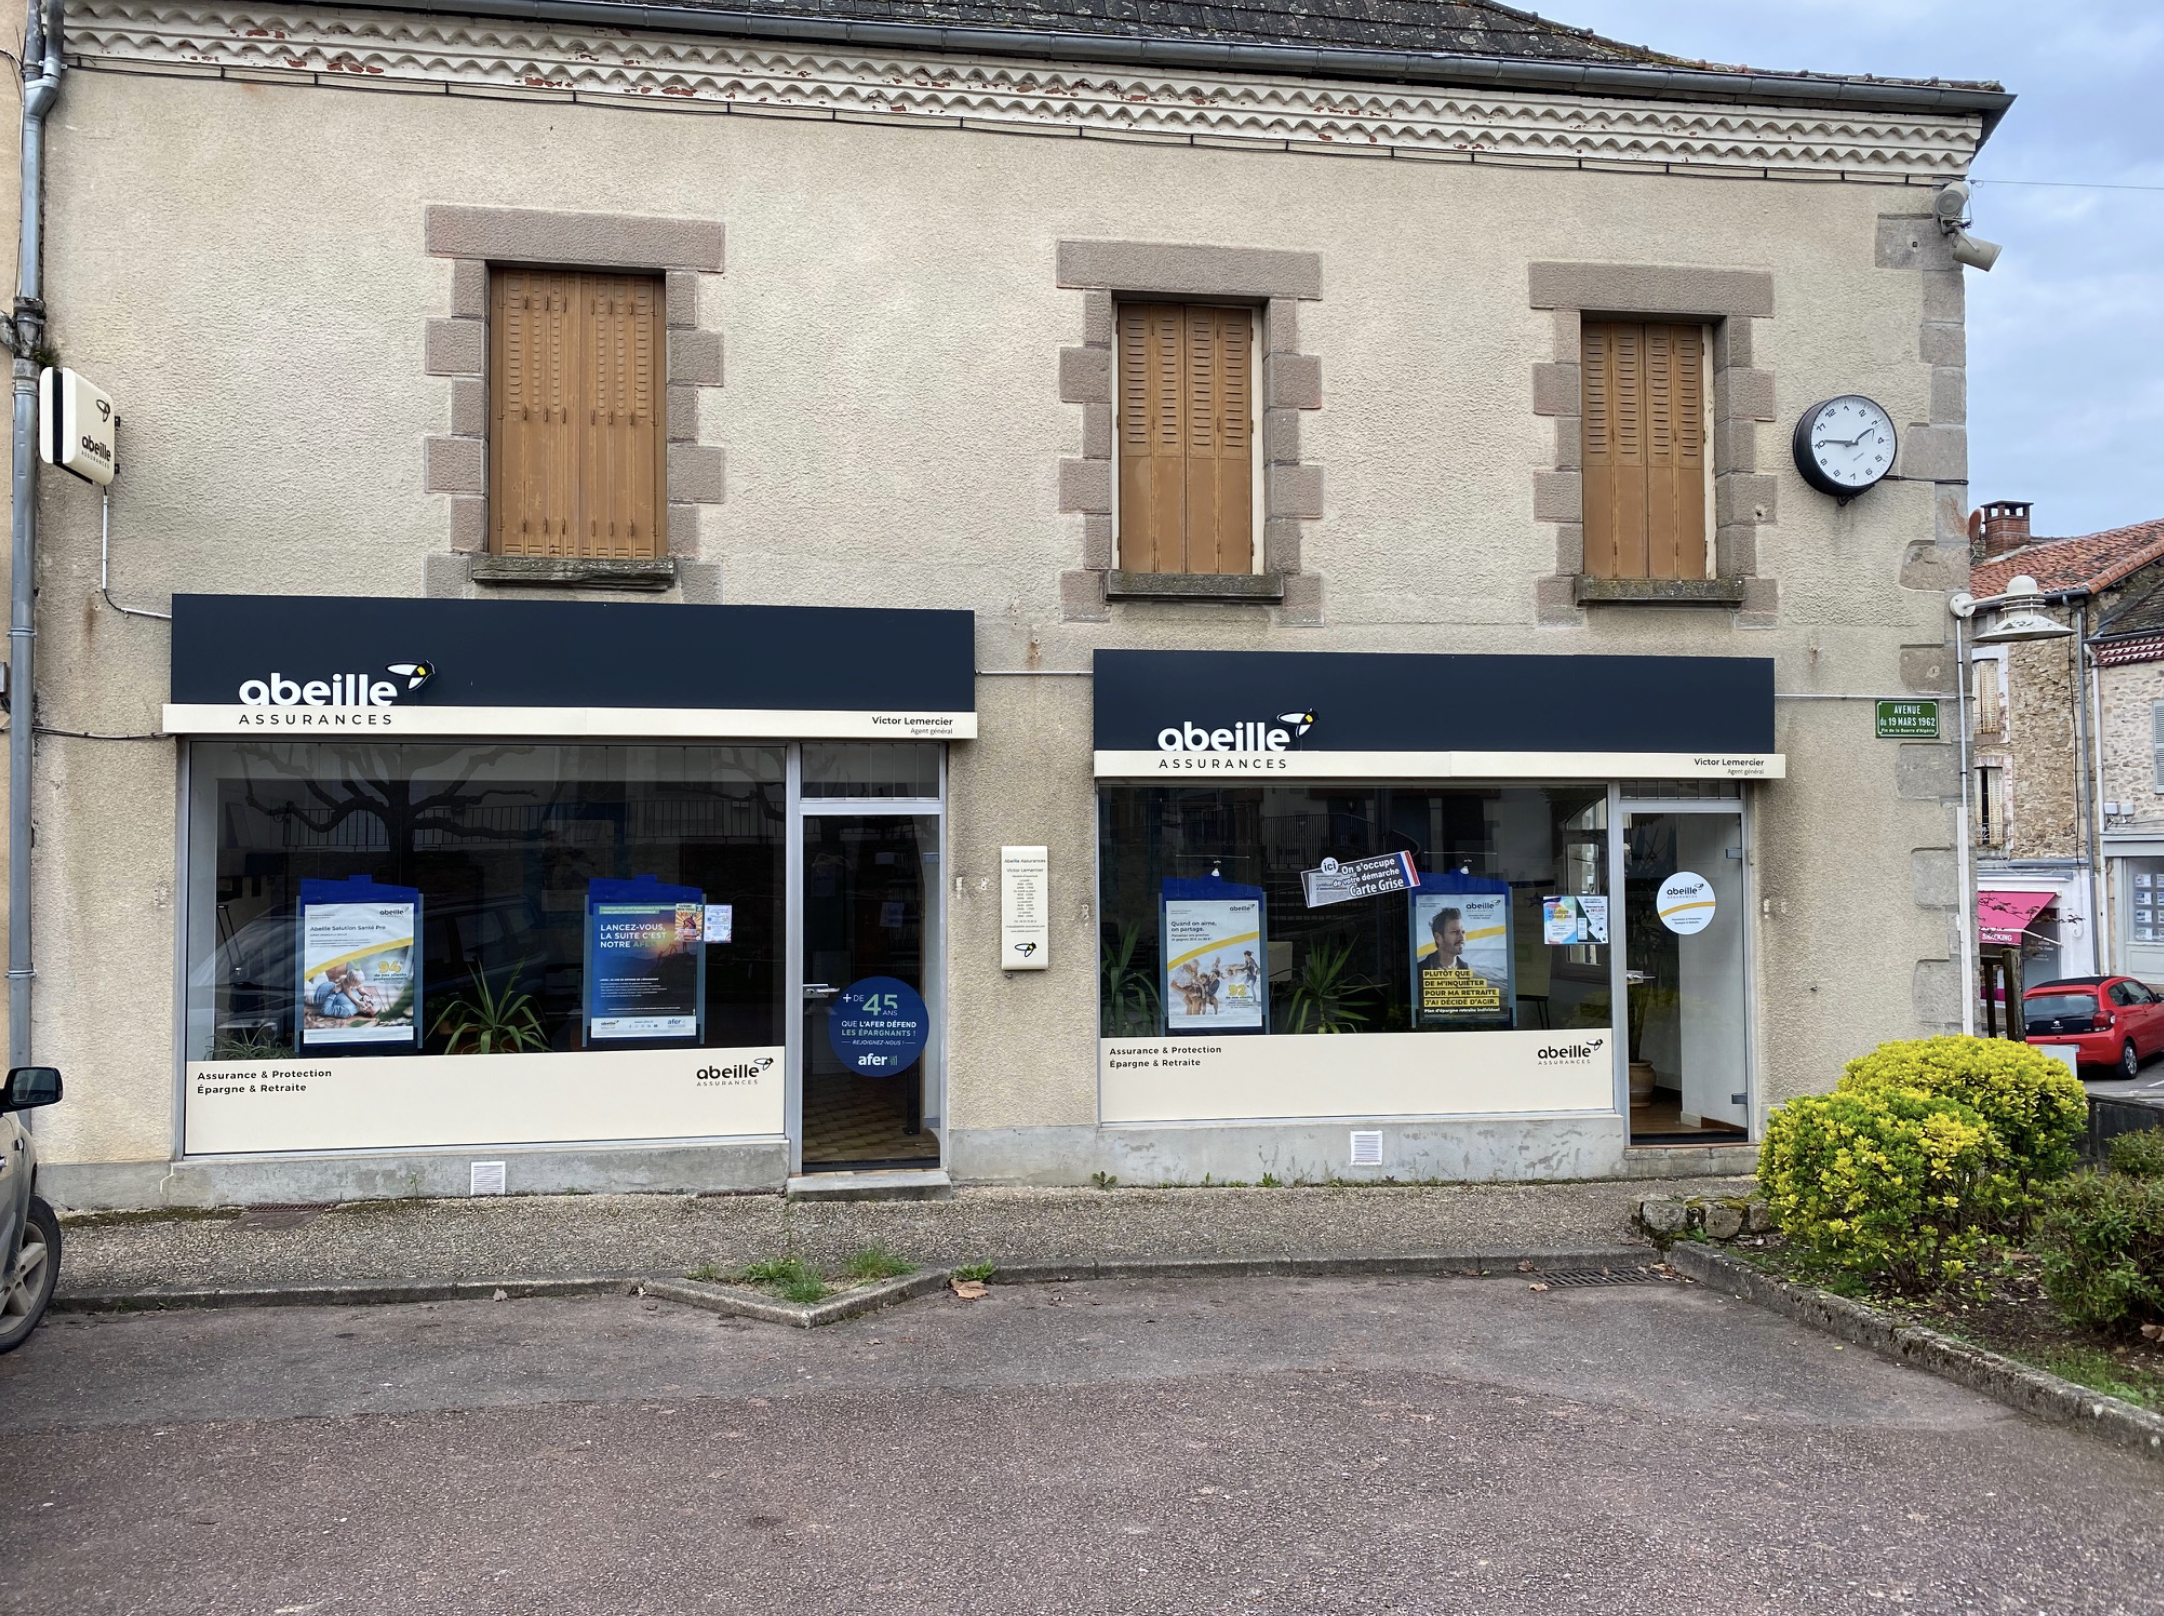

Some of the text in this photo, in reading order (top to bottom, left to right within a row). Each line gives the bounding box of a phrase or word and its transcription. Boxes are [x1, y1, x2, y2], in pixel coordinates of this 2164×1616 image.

[1825, 408, 1836, 418] 12
[1858, 409, 1867, 418] 2
[1816, 423, 1826, 431] 11
[81, 434, 111, 461] abeille
[1814, 440, 1826, 449] 10
[1820, 458, 1828, 466] 9
[1874, 454, 1883, 462] 5
[1833, 469, 1841, 477] 8
[1865, 467, 1873, 475] 6
[238, 672, 398, 706] abeille
[1894, 705, 1921, 714] AVENUE
[238, 714, 392, 725] ASSURANCES
[872, 716, 953, 725] Victor Lemercier
[1880, 717, 1936, 726] du 19 MARS 1962
[930, 728, 953, 736] général
[1158, 721, 1291, 751] abeille
[1158, 759, 1287, 769] ASSURANCES
[1722, 758, 1764, 766] Lemercier
[1323, 861, 1337, 871] ici
[1341, 857, 1395, 875] On s'occupe
[1361, 868, 1400, 882] démarche
[1350, 878, 1404, 897] Carte Grise
[1666, 887, 1697, 895] abeille
[1466, 902, 1494, 910] abeille
[379, 908, 404, 916] abeille
[600, 923, 666, 932] LANCEZ-VOUS,
[615, 932, 640, 940] SUITE
[642, 931, 667, 939] C'EST
[1424, 969, 1471, 978] PLUTÔT QUE
[862, 993, 898, 1016] 45
[841, 1020, 857, 1028] QUE
[887, 1020, 917, 1028] DÉFEND
[858, 1028, 911, 1037] ÉPARGNANTS
[1172, 1046, 1222, 1054] Protection
[1538, 1045, 1591, 1059] abeille
[858, 1053, 888, 1066] afer
[1110, 1059, 1150, 1069] Épargne
[1162, 1059, 1201, 1067] Retraite
[197, 1069, 332, 1080] Assurance & Protection
[696, 1064, 759, 1080] abeille
[197, 1083, 307, 1095] Épargne & Retraite
